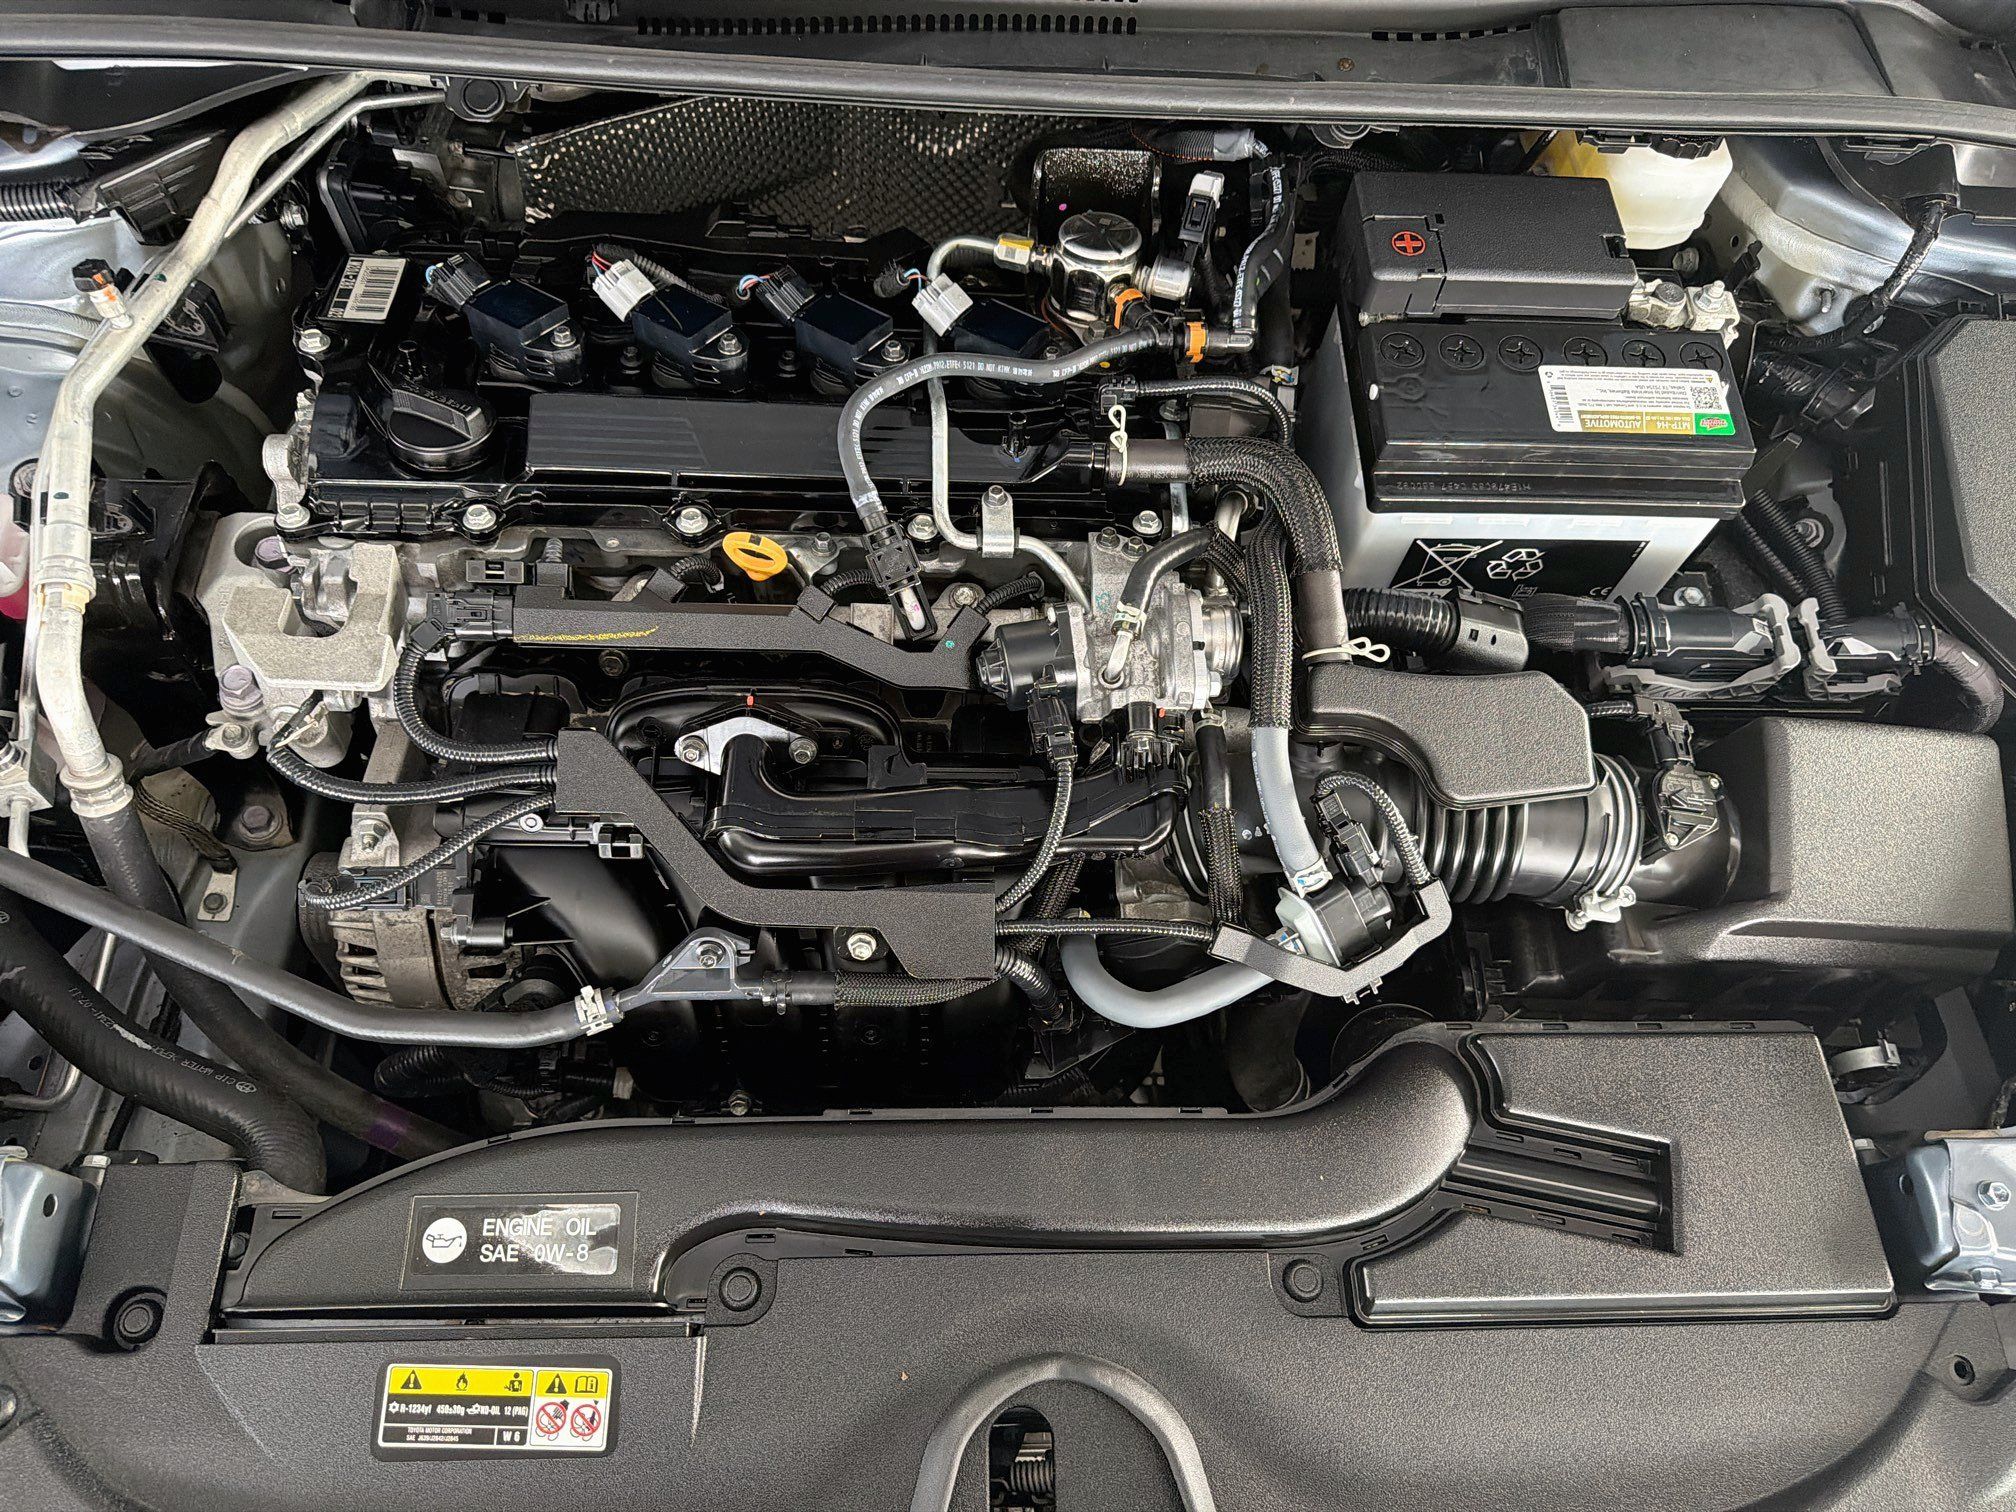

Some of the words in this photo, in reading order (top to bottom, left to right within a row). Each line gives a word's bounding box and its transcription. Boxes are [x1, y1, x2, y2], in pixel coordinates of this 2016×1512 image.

[986, 363, 995, 372] NOT
[1584, 419, 1642, 429] AUTOMOTIVE
[1656, 420, 1691, 430] MTP-H4
[181, 1059, 216, 1076] WATER
[482, 1217, 553, 1237] ENGINE
[565, 1217, 597, 1237] OIL
[479, 1243, 519, 1263] SAE
[534, 1243, 590, 1263] 0W-8
[400, 1403, 432, 1415] R-1234yf
[504, 1405, 512, 1415] 12
[512, 1405, 529, 1417] (PAG)
[407, 1426, 425, 1434] TOYOTA
[502, 1431, 512, 1442] W
[513, 1431, 521, 1442] 6
